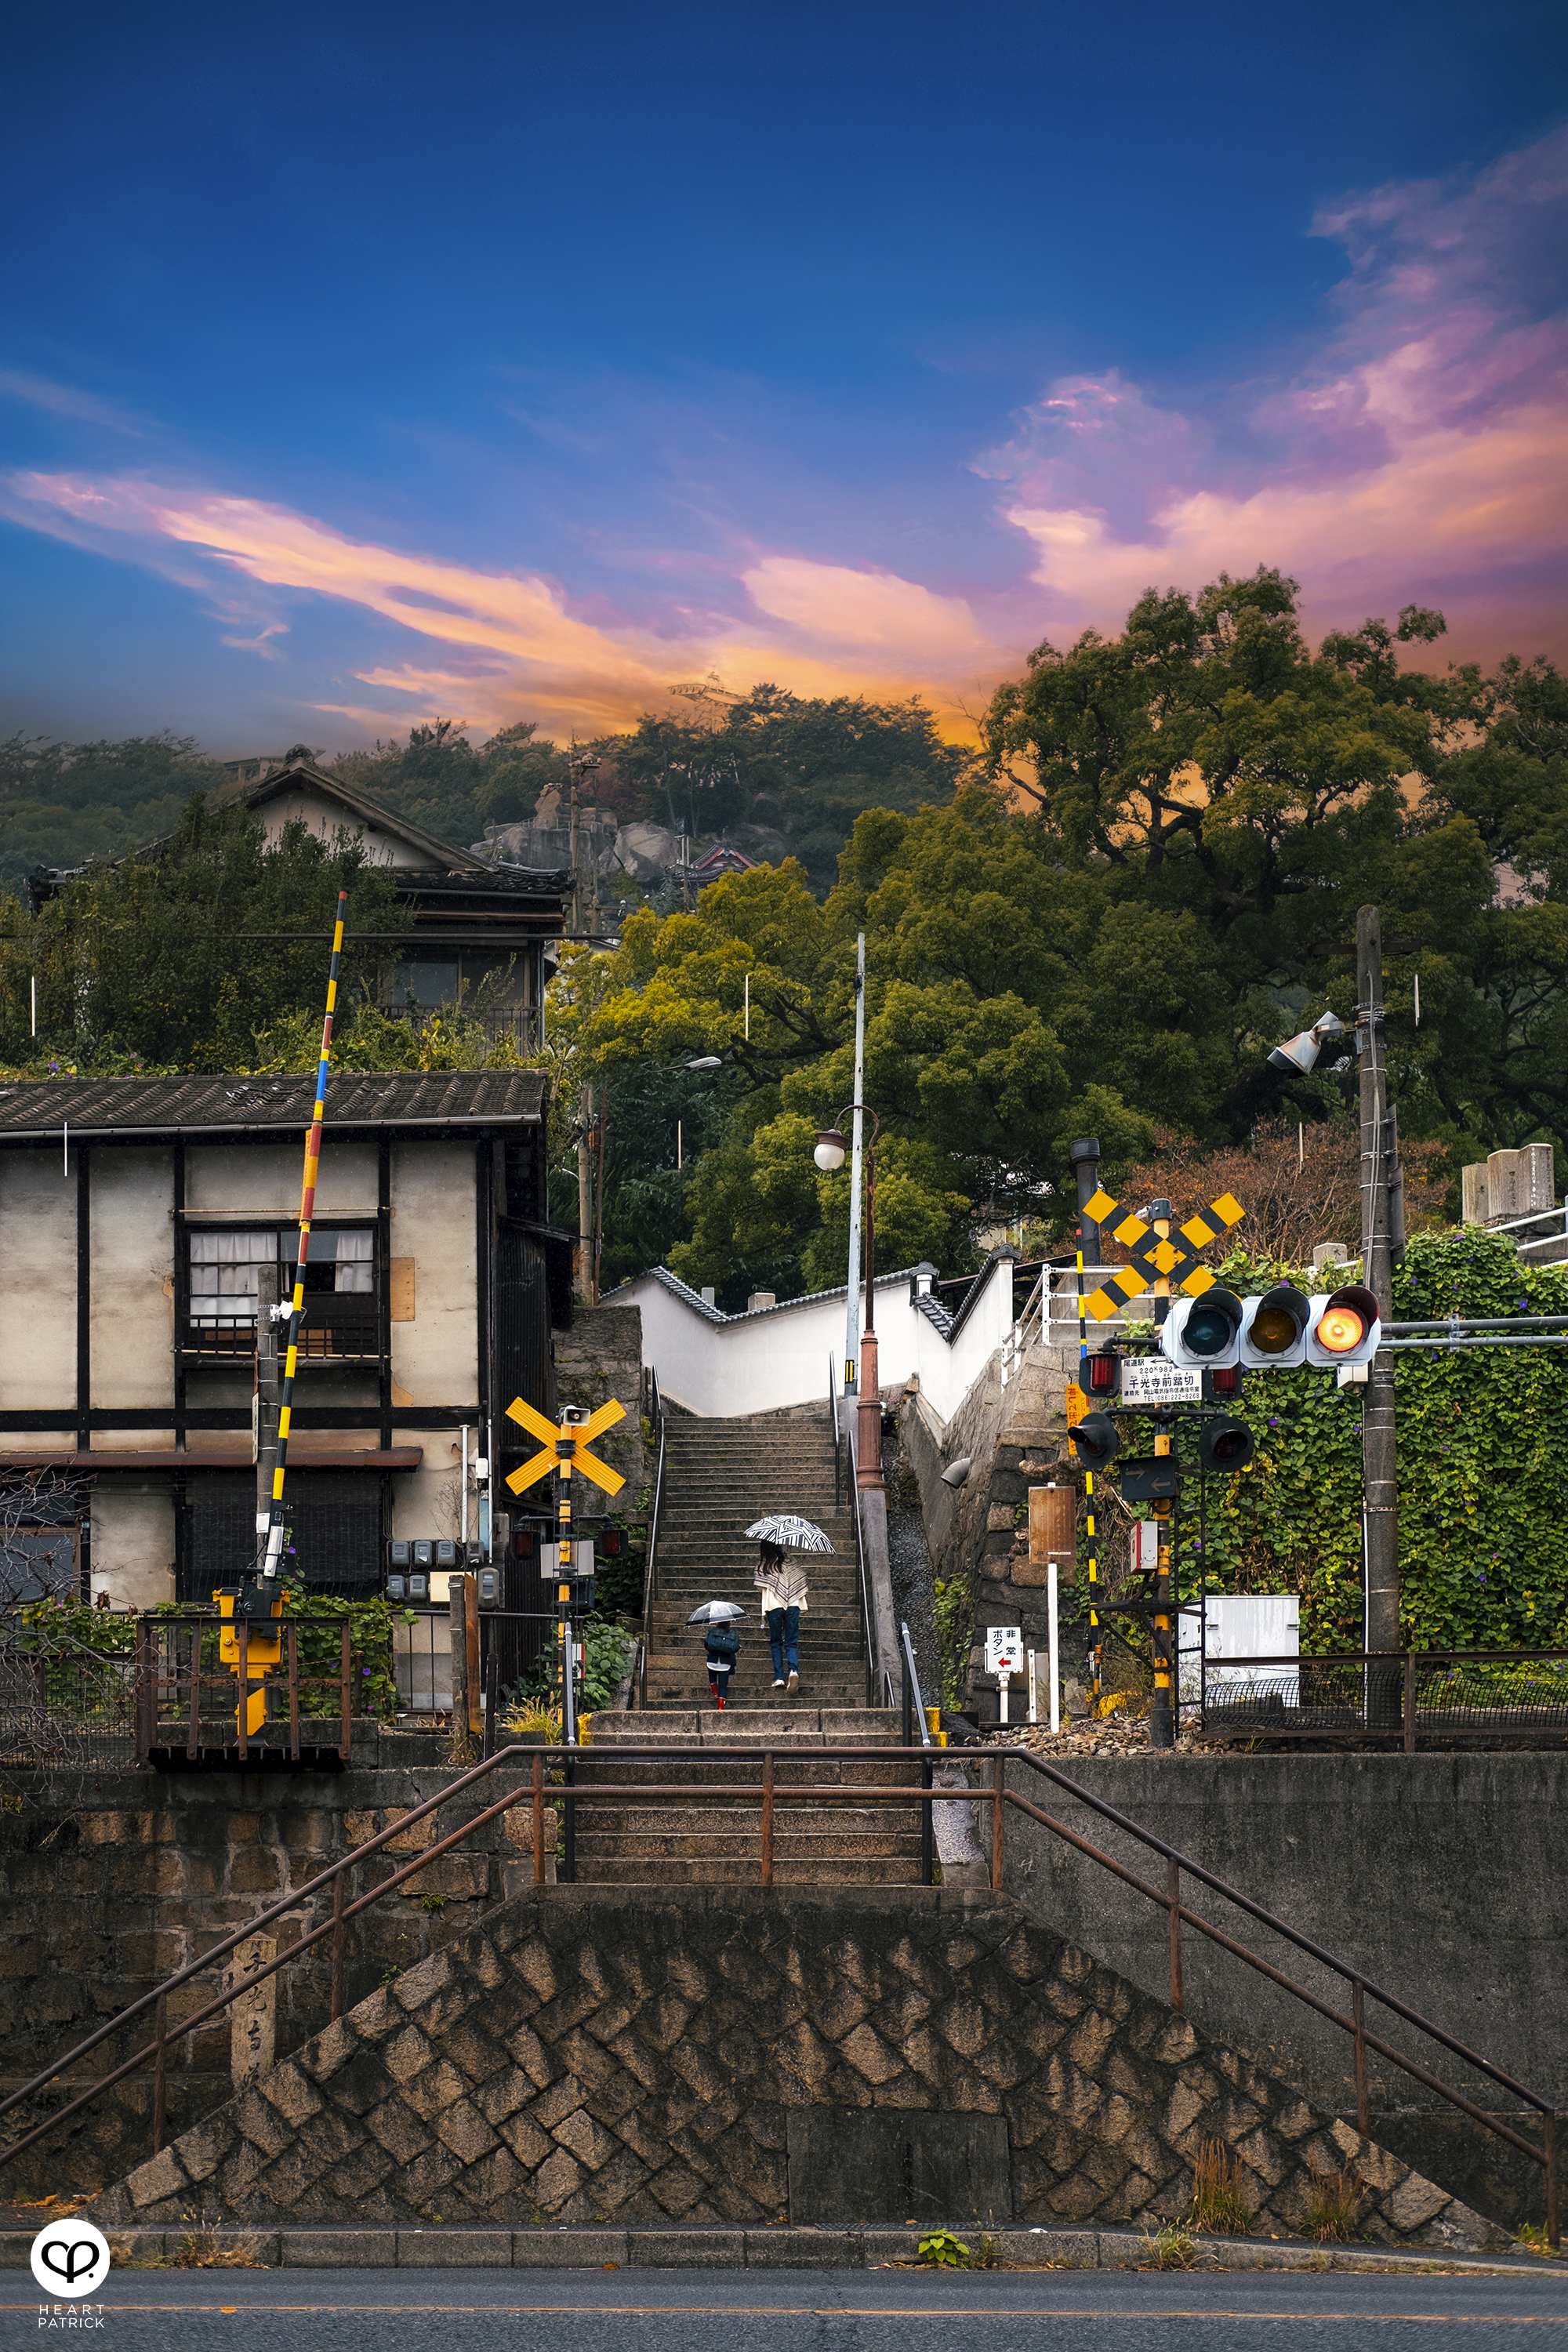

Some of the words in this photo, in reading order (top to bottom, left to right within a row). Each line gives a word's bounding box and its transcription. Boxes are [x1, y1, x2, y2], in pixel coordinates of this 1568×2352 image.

[1129, 1375, 1194, 1388] 千光寺前踏切
[993, 1629, 1003, 1656] ボタン
[1006, 1629, 1016, 1655] 非常
